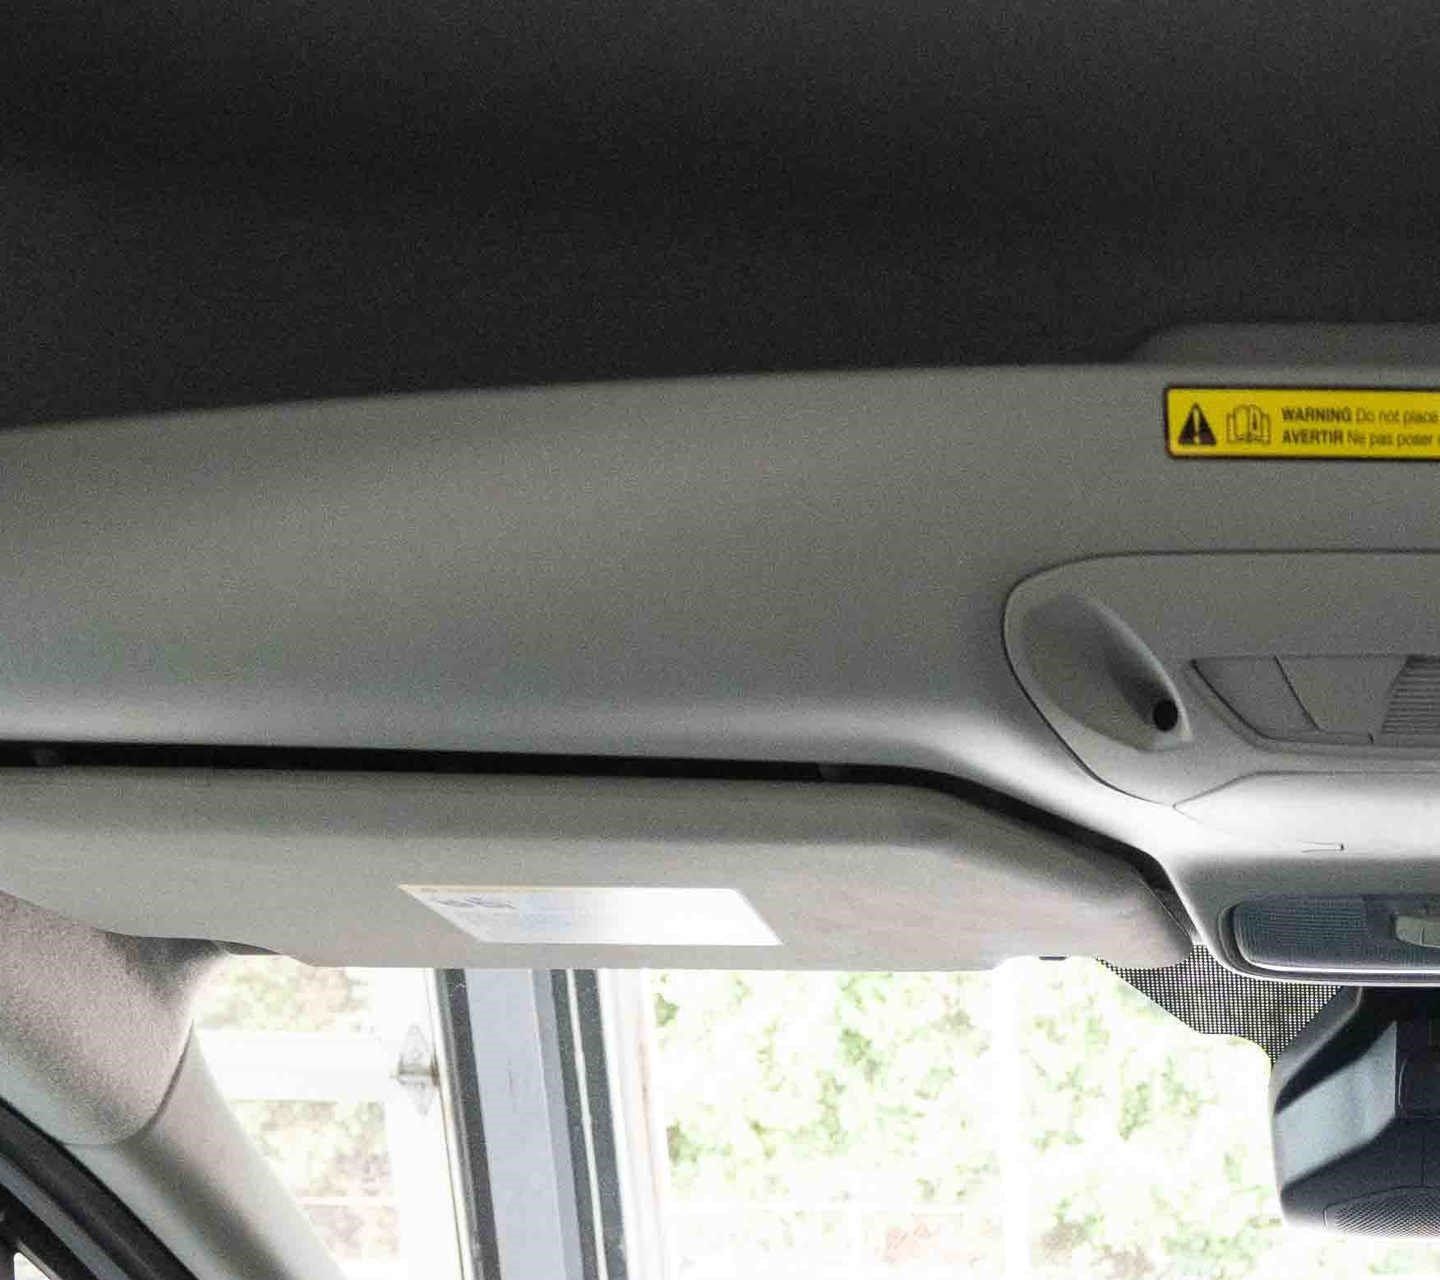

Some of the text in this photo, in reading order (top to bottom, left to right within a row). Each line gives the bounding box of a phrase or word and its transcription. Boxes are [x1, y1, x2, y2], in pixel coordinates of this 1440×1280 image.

[1281, 406, 1351, 423] WARNING
[1356, 409, 1375, 424] Do
[1379, 409, 1400, 424] not
[1403, 410, 1439, 428] place
[1282, 429, 1344, 445] AVERTIR
[1348, 430, 1367, 445] Ne
[1370, 432, 1393, 448] pas
